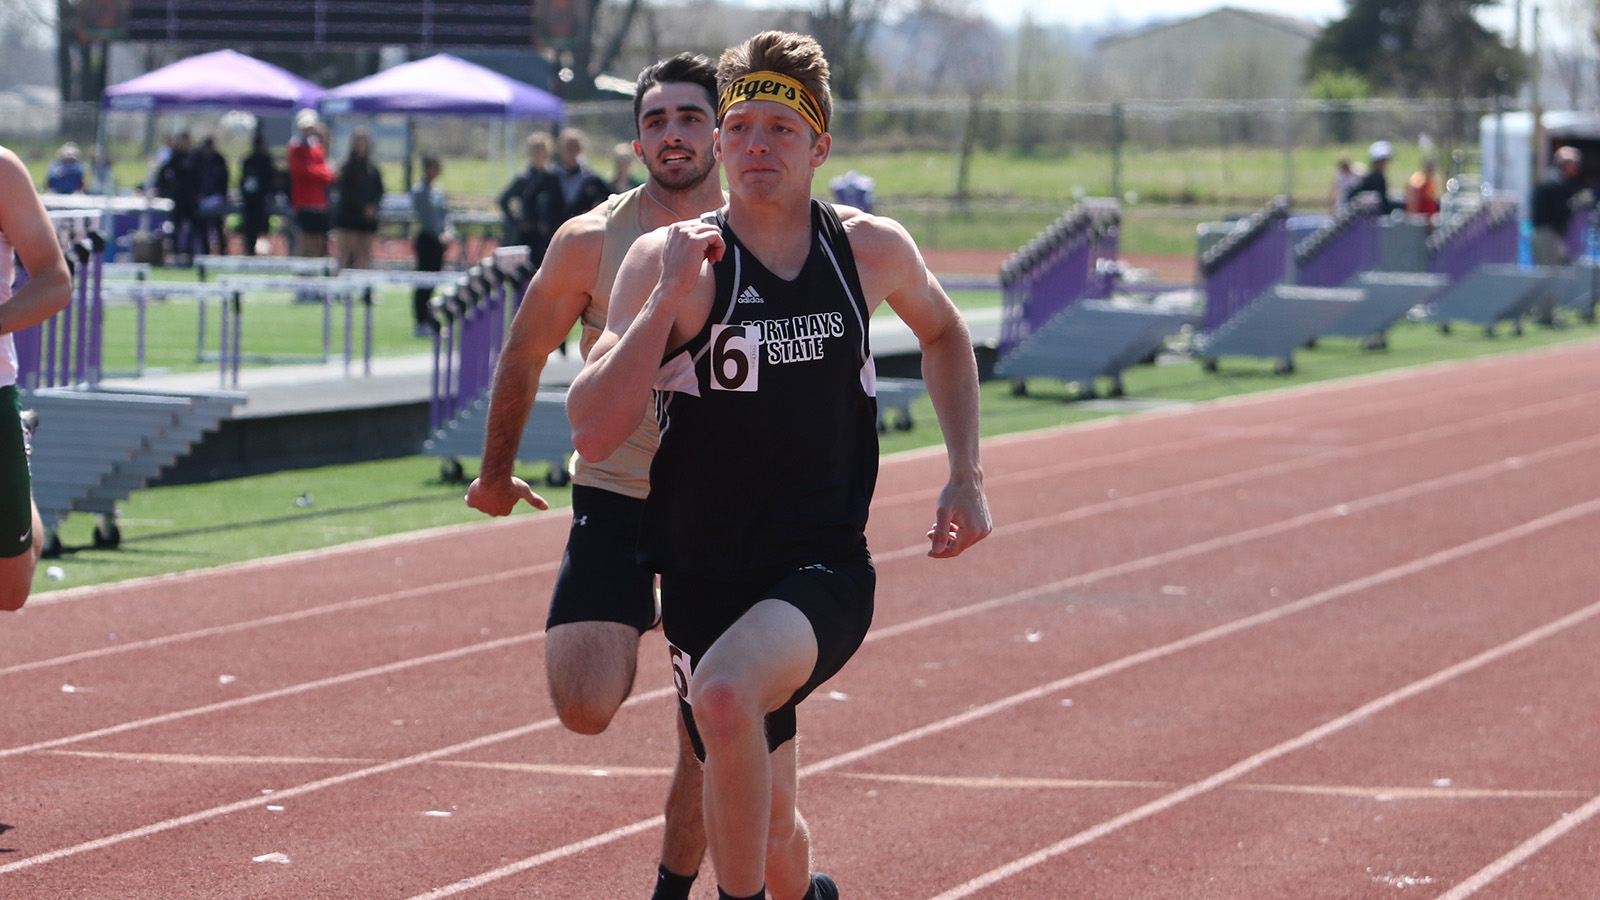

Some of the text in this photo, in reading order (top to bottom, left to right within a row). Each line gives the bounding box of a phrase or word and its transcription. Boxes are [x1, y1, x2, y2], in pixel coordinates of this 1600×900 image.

[728, 77, 796, 101] Tigers
[738, 296, 764, 304] adidas
[741, 312, 844, 345] ORT HAYS
[712, 326, 749, 389] 6
[767, 337, 824, 365] STATE
[669, 645, 688, 698] 6
